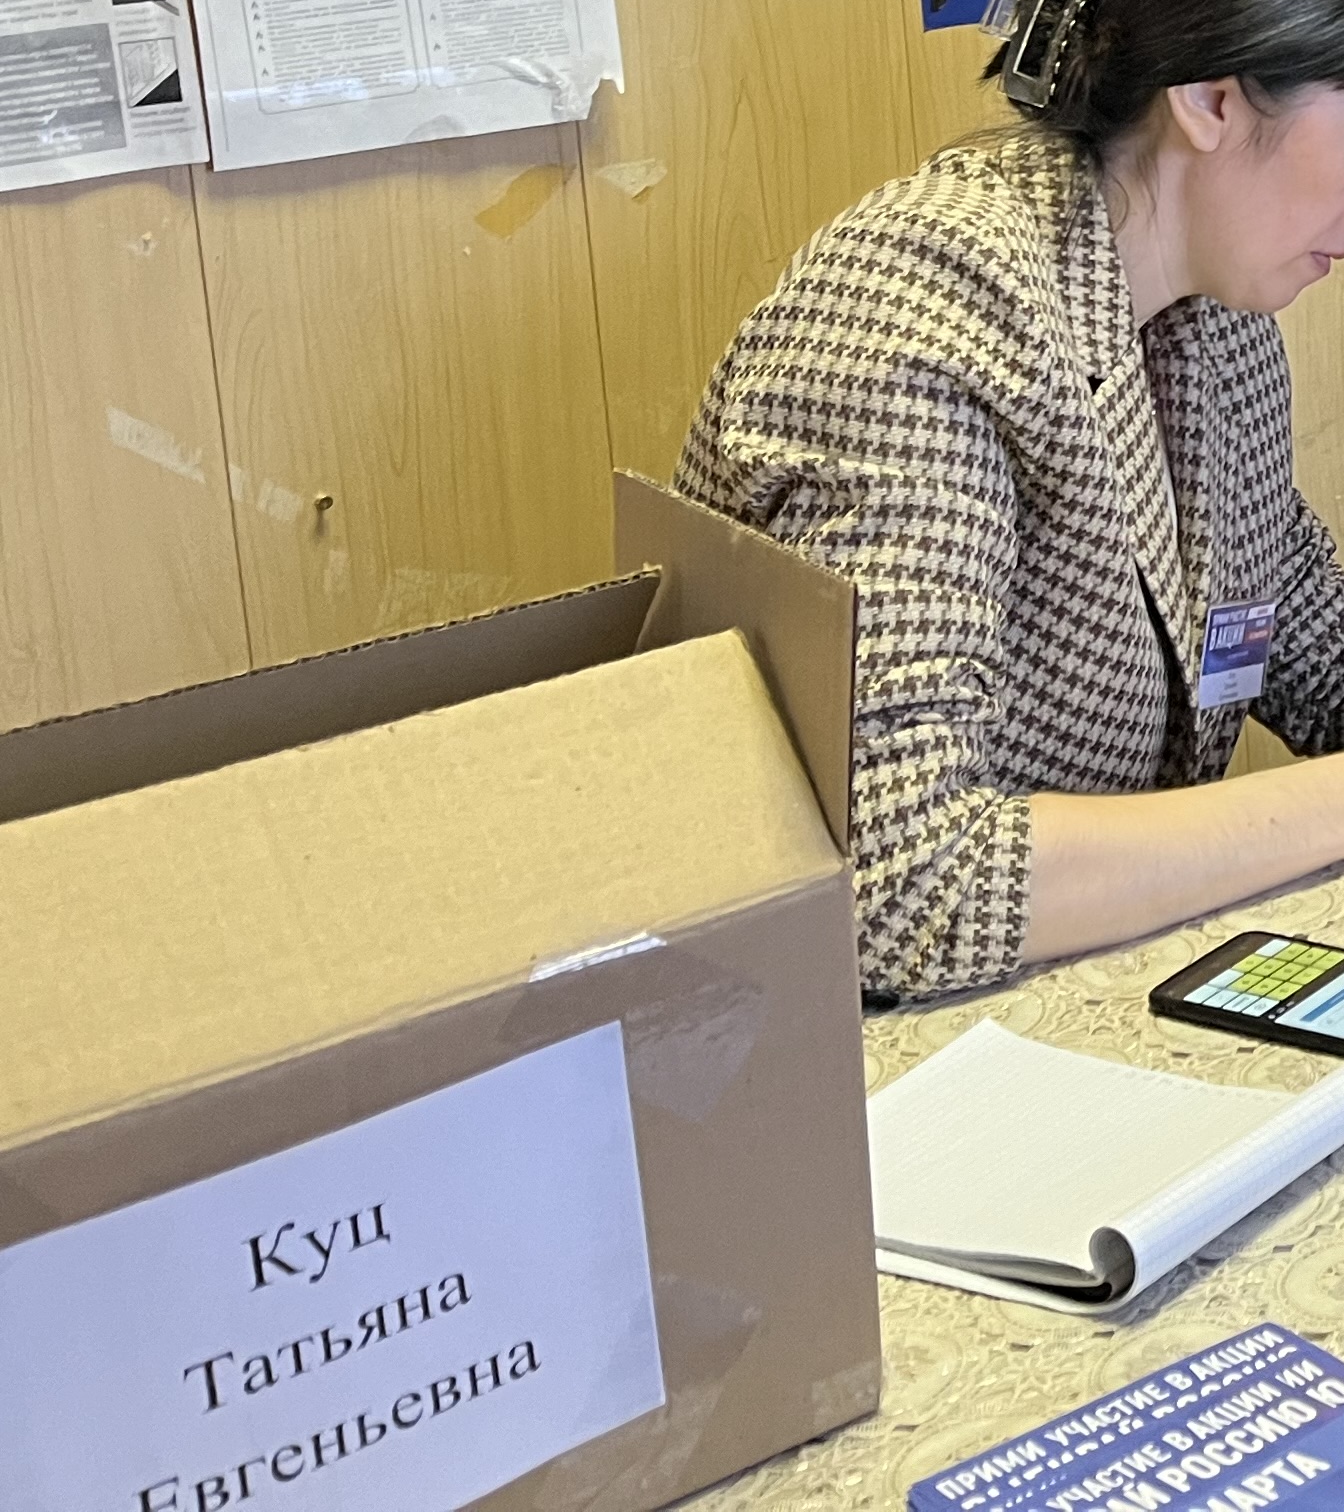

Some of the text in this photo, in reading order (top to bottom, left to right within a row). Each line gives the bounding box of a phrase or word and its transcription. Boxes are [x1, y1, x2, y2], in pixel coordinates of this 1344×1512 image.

[242, 1200, 391, 1291] Куц
[183, 1270, 472, 1415] Татьяна
[134, 1337, 542, 1512] Евгеньевна
[935, 1328, 1285, 1500] ПРИМИ УЧАСТИЕ В АКЦИИ
[1045, 1441, 1173, 1512] УЧАСТИЕ
[1161, 1430, 1194, 1452] В
[1185, 1380, 1282, 1440] АКЦИИ
[1156, 1399, 1317, 1493] РОССИЮ
